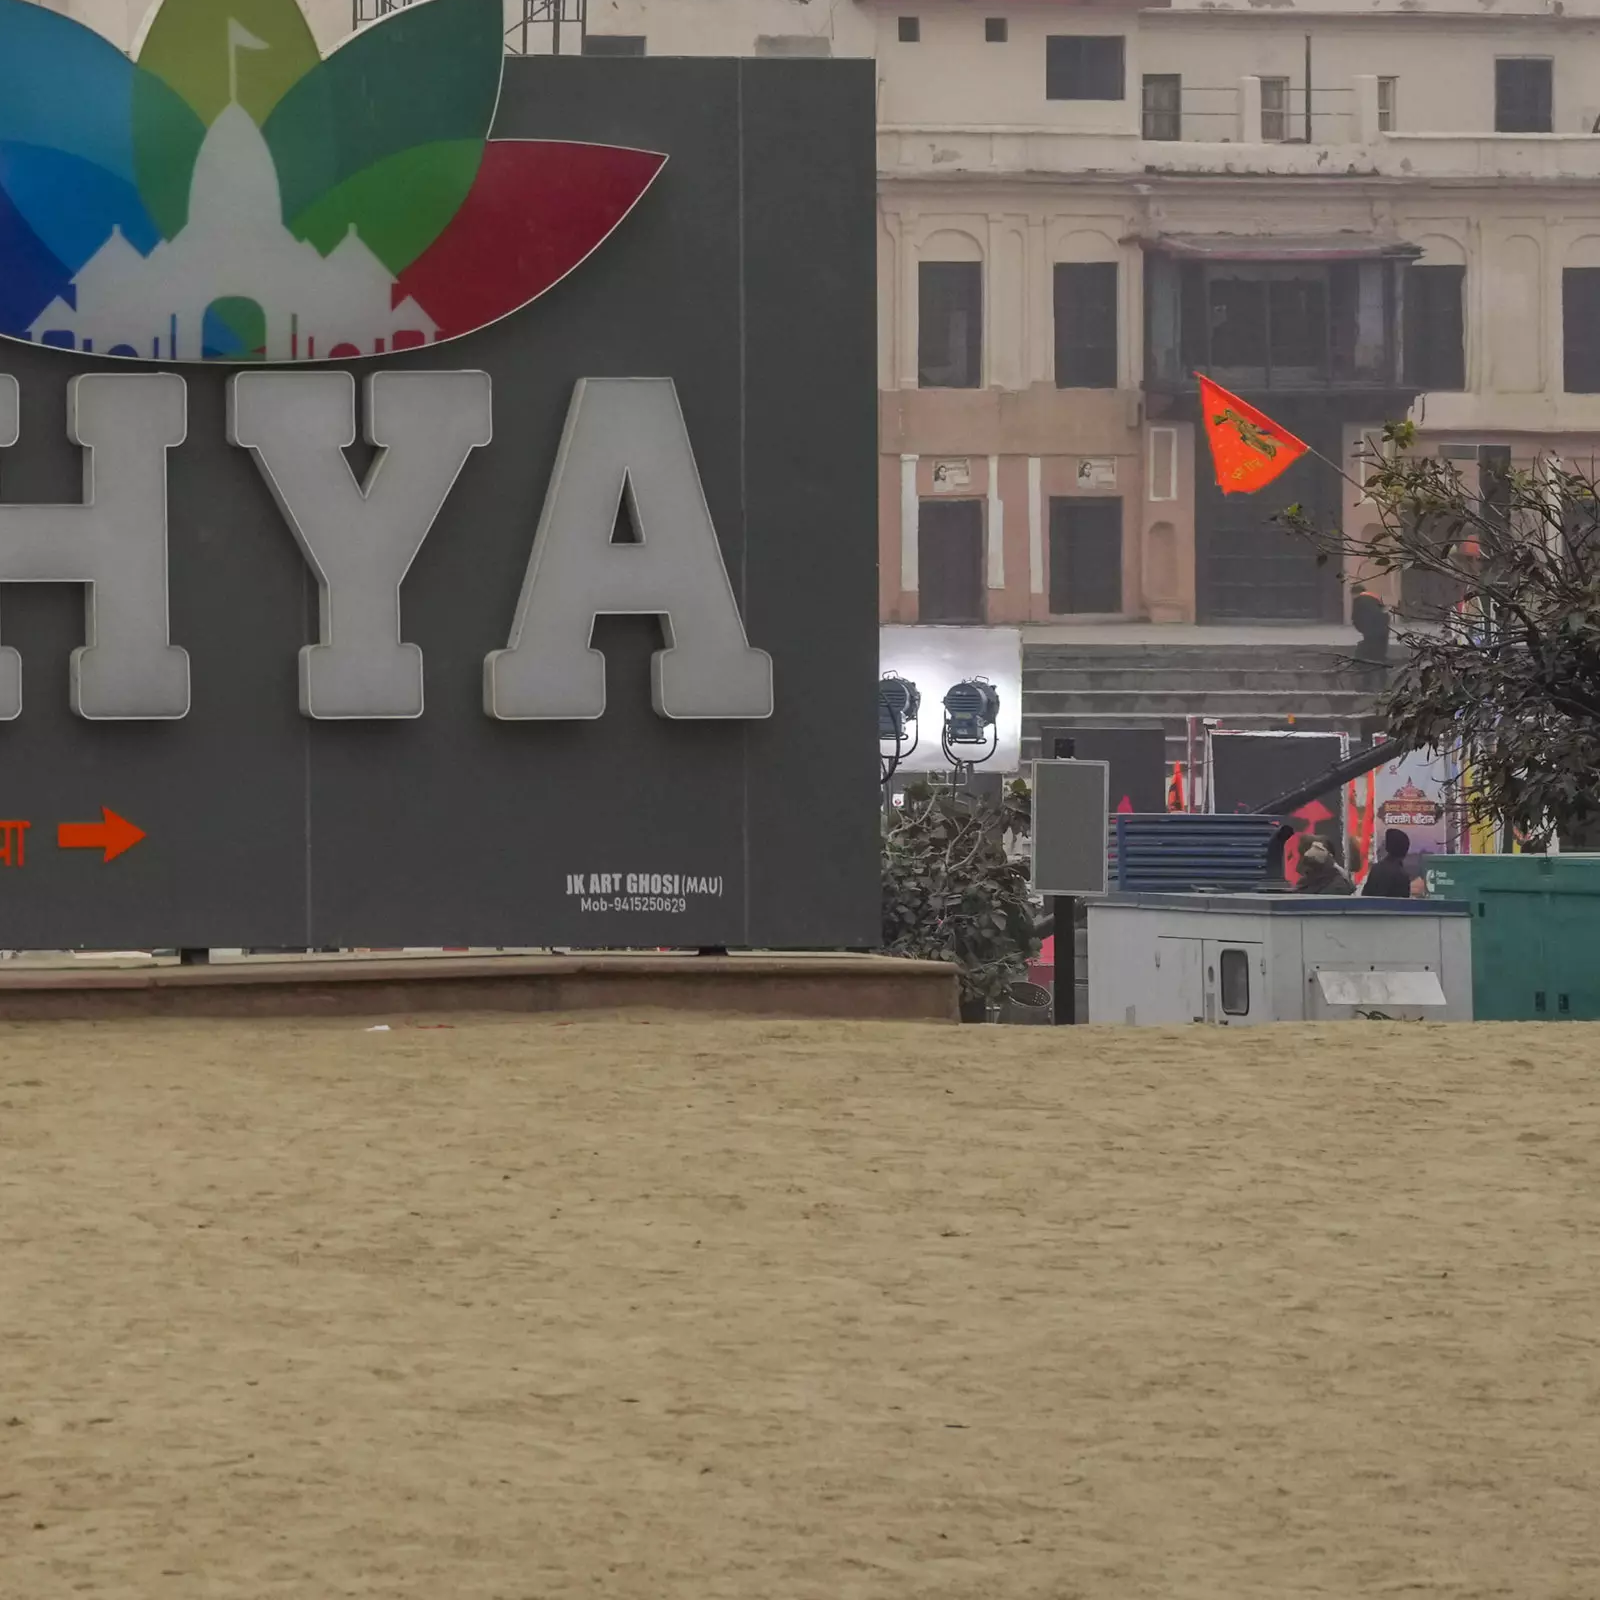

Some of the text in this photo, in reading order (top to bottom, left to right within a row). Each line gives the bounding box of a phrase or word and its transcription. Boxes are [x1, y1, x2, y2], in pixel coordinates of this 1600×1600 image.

[566, 873, 723, 897] JK ART GHOSI (MAU)
[580, 897, 686, 913] Mob-9415250629
